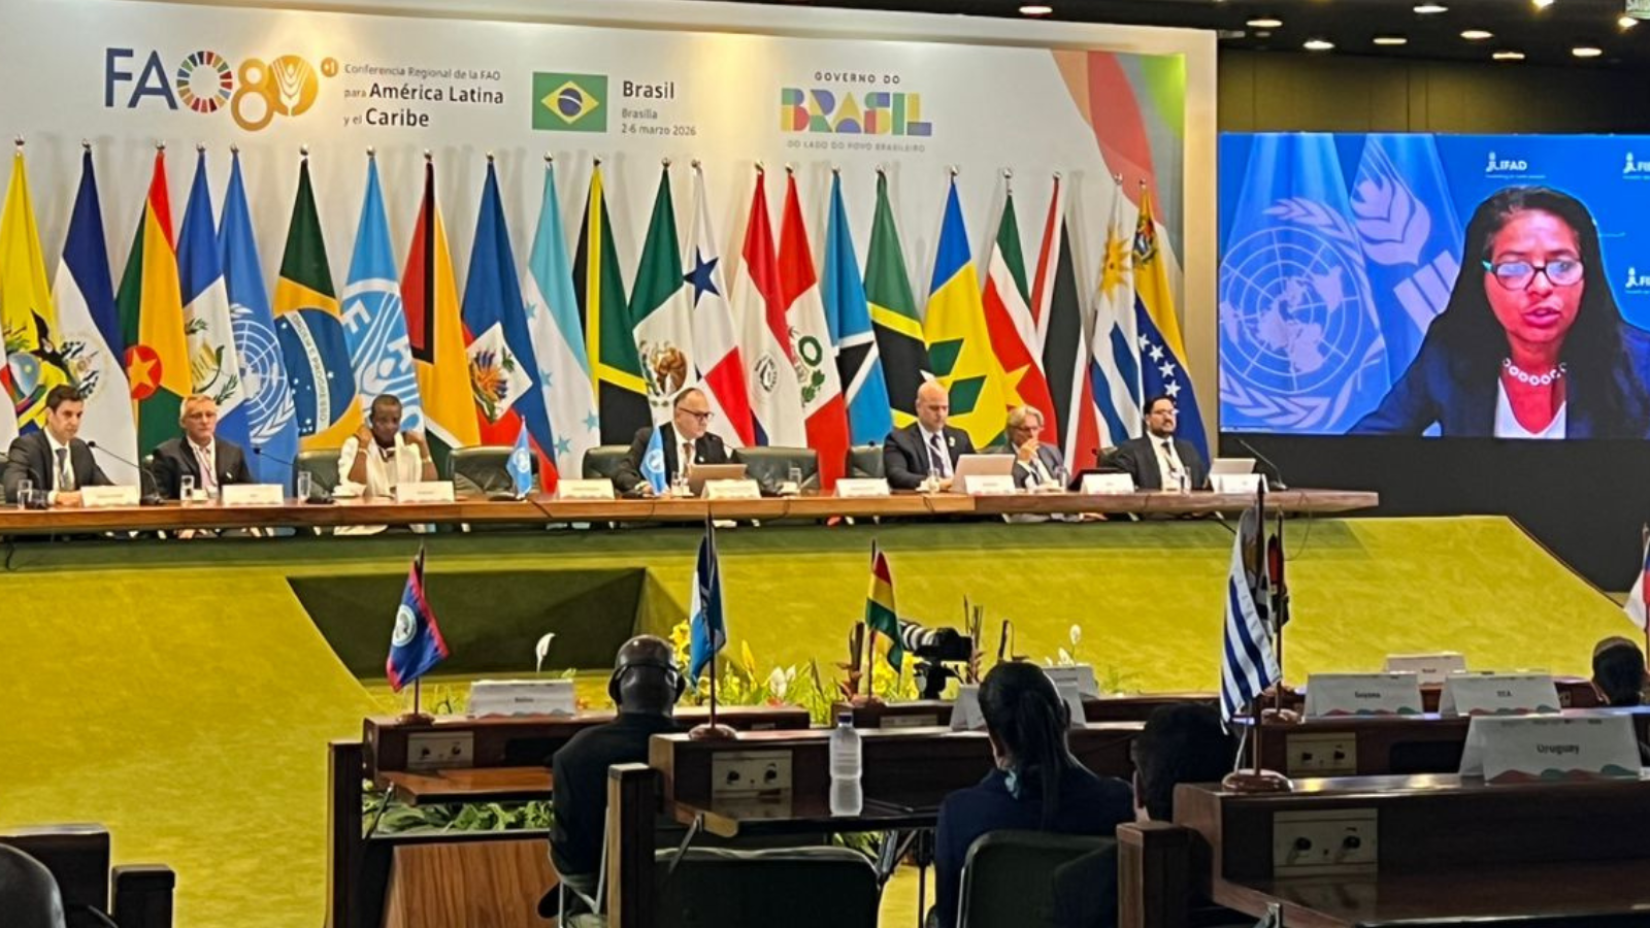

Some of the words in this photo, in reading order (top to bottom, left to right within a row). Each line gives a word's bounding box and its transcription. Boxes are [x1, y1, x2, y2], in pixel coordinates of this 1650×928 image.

[105, 47, 233, 113] FAO
[344, 64, 405, 76] Conferencia
[408, 67, 451, 79] Regional
[454, 69, 467, 79] de
[469, 70, 478, 80] la
[480, 70, 500, 81] FAO
[814, 71, 876, 83] GOVERNO
[883, 75, 901, 84] DO
[344, 89, 366, 99] para
[369, 82, 443, 101] América
[449, 86, 504, 104] Latina
[623, 80, 674, 99] Brasil
[343, 116, 350, 127] y
[352, 115, 362, 125] el
[365, 107, 430, 127] Caribe
[781, 88, 932, 137] BRASIL
[639, 125, 671, 135] marzo
[673, 125, 697, 136] 2026
[787, 140, 801, 149] DO
[803, 140, 828, 149] LADO
[831, 141, 845, 150] DO
[1536, 743, 1580, 755] Uruguay
